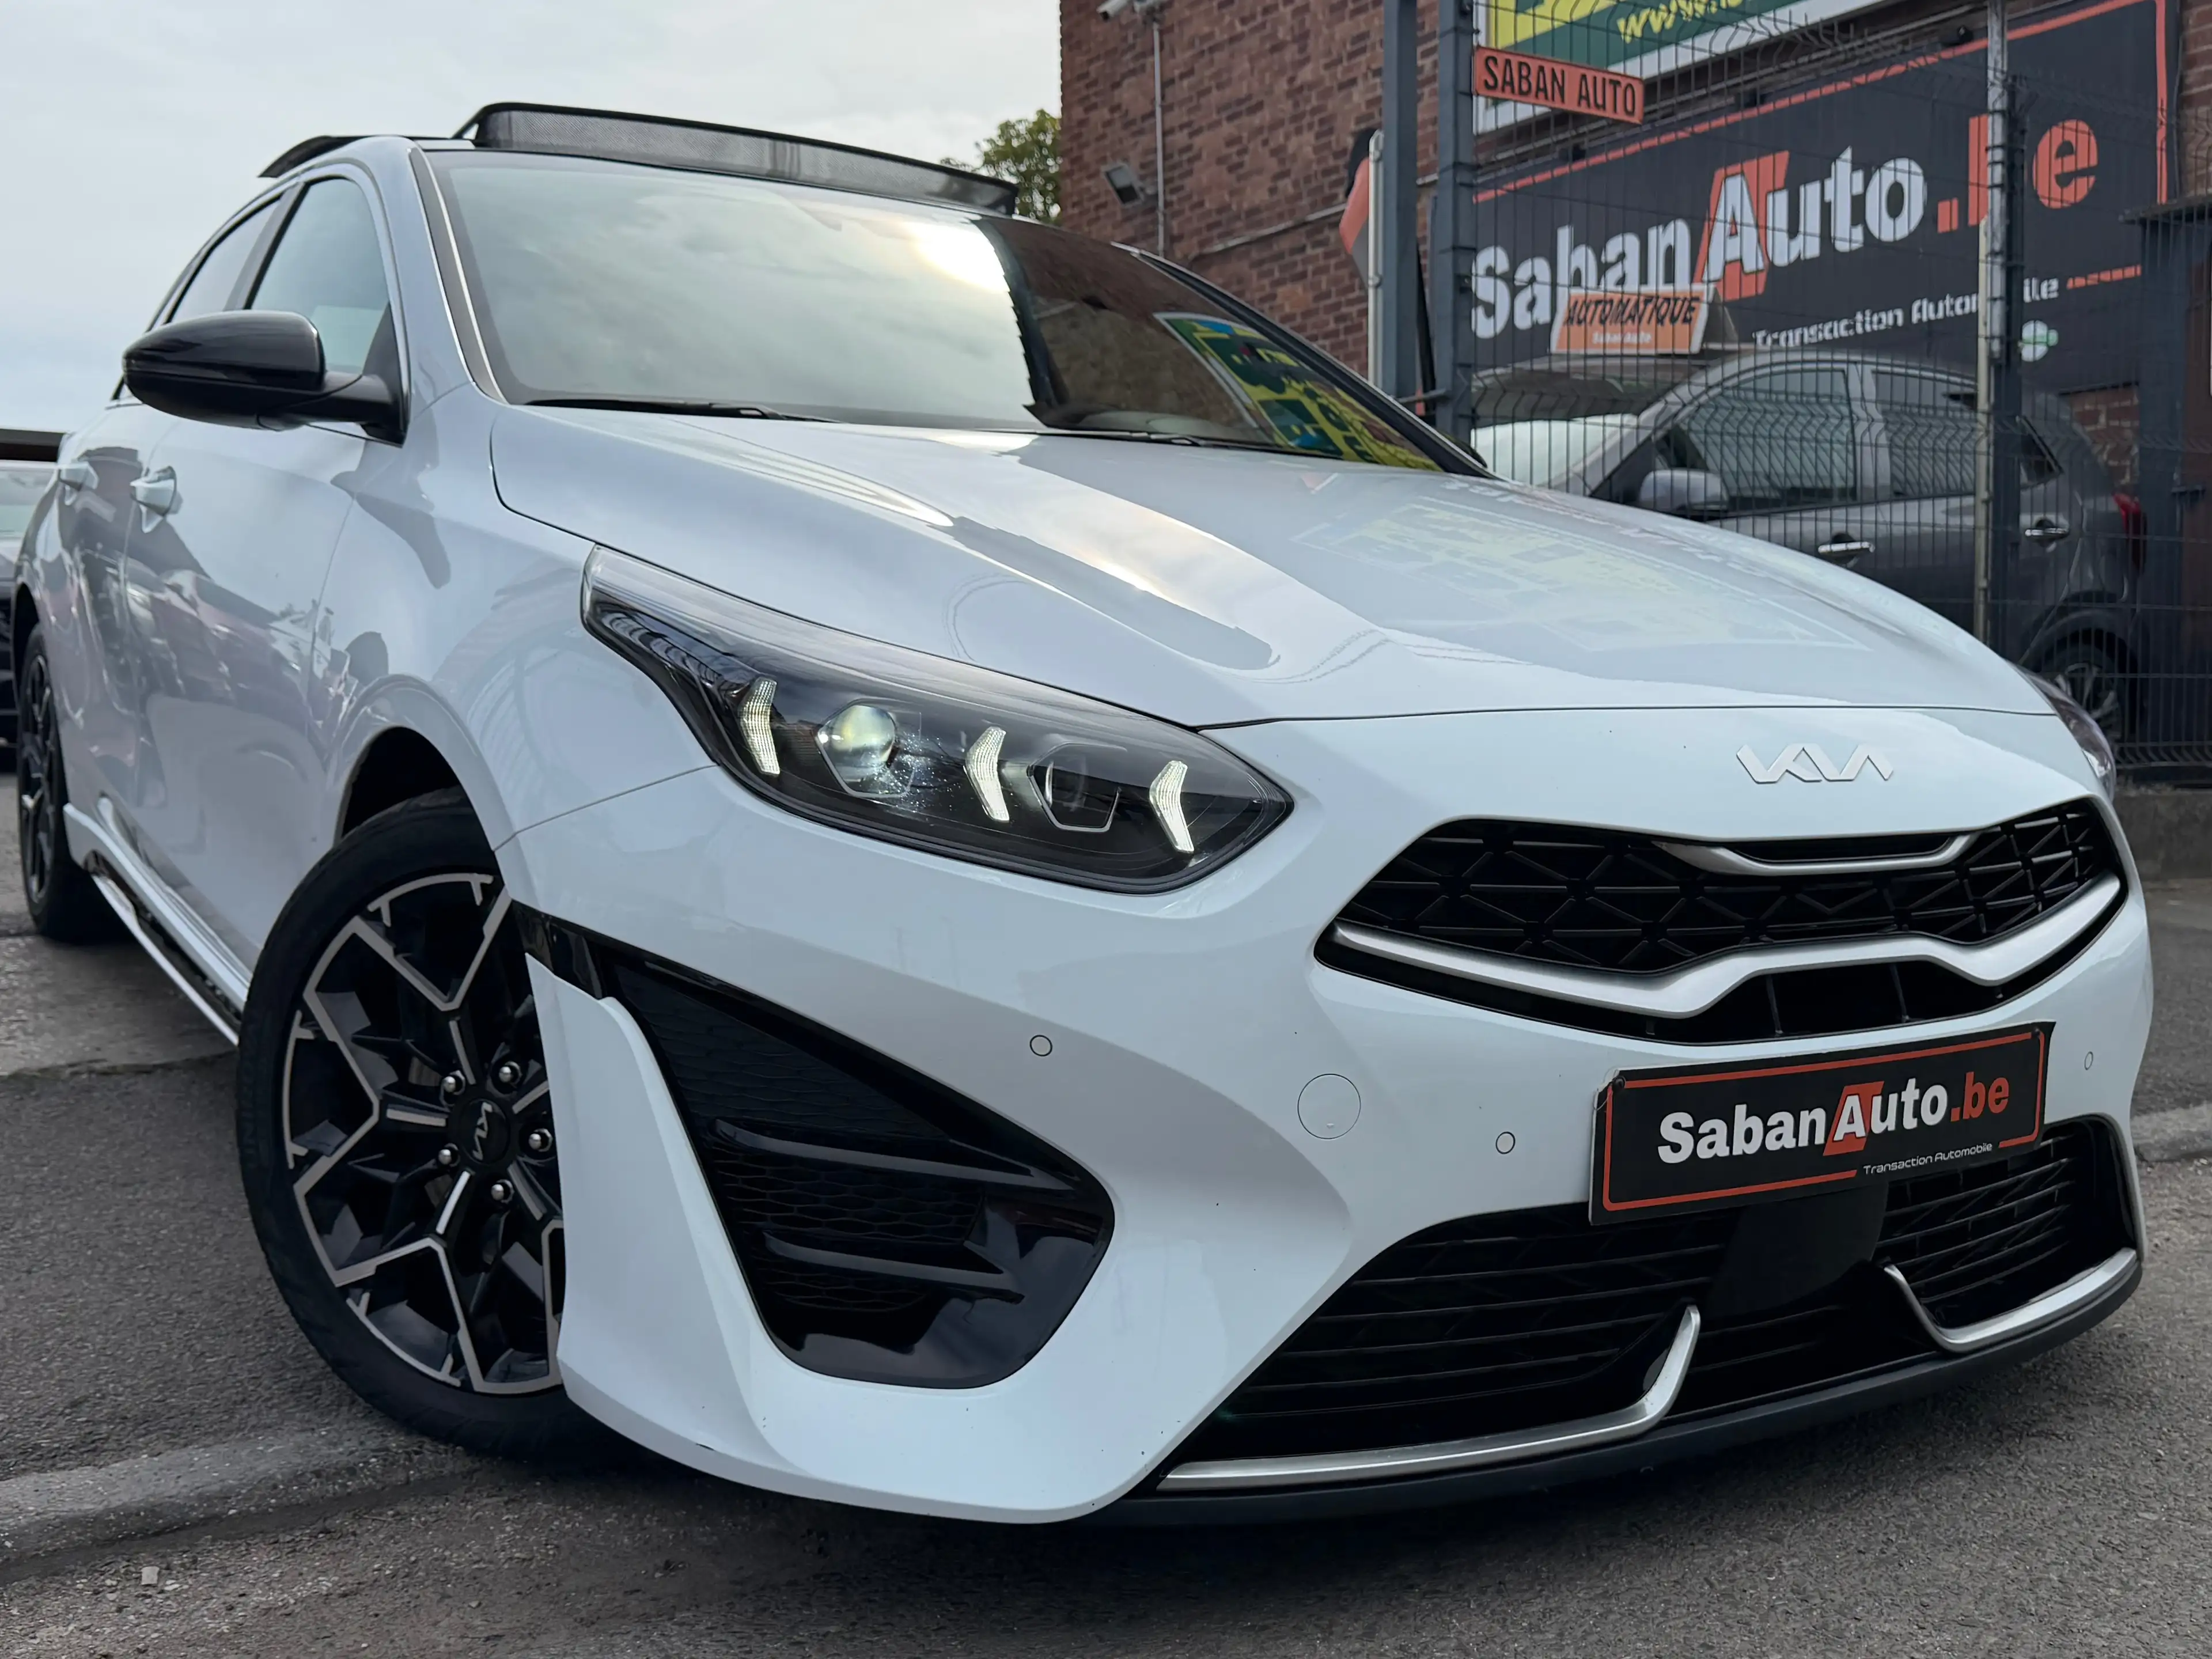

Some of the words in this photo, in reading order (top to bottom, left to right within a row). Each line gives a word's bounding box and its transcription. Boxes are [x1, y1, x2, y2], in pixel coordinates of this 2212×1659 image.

[1484, 56, 1565, 104] SABAN
[1577, 74, 1636, 117] AUTO
[1563, 296, 1702, 327] AUTOMATIQUE
[1752, 308, 1904, 346] Transaction
[1911, 278, 2059, 324] Autoile
[1736, 743, 1893, 784] KIA
[1658, 1071, 2009, 1164] SabanAuto.be
[1863, 1156, 1933, 1175] Transaction
[1934, 1142, 1993, 1162] Automobile
